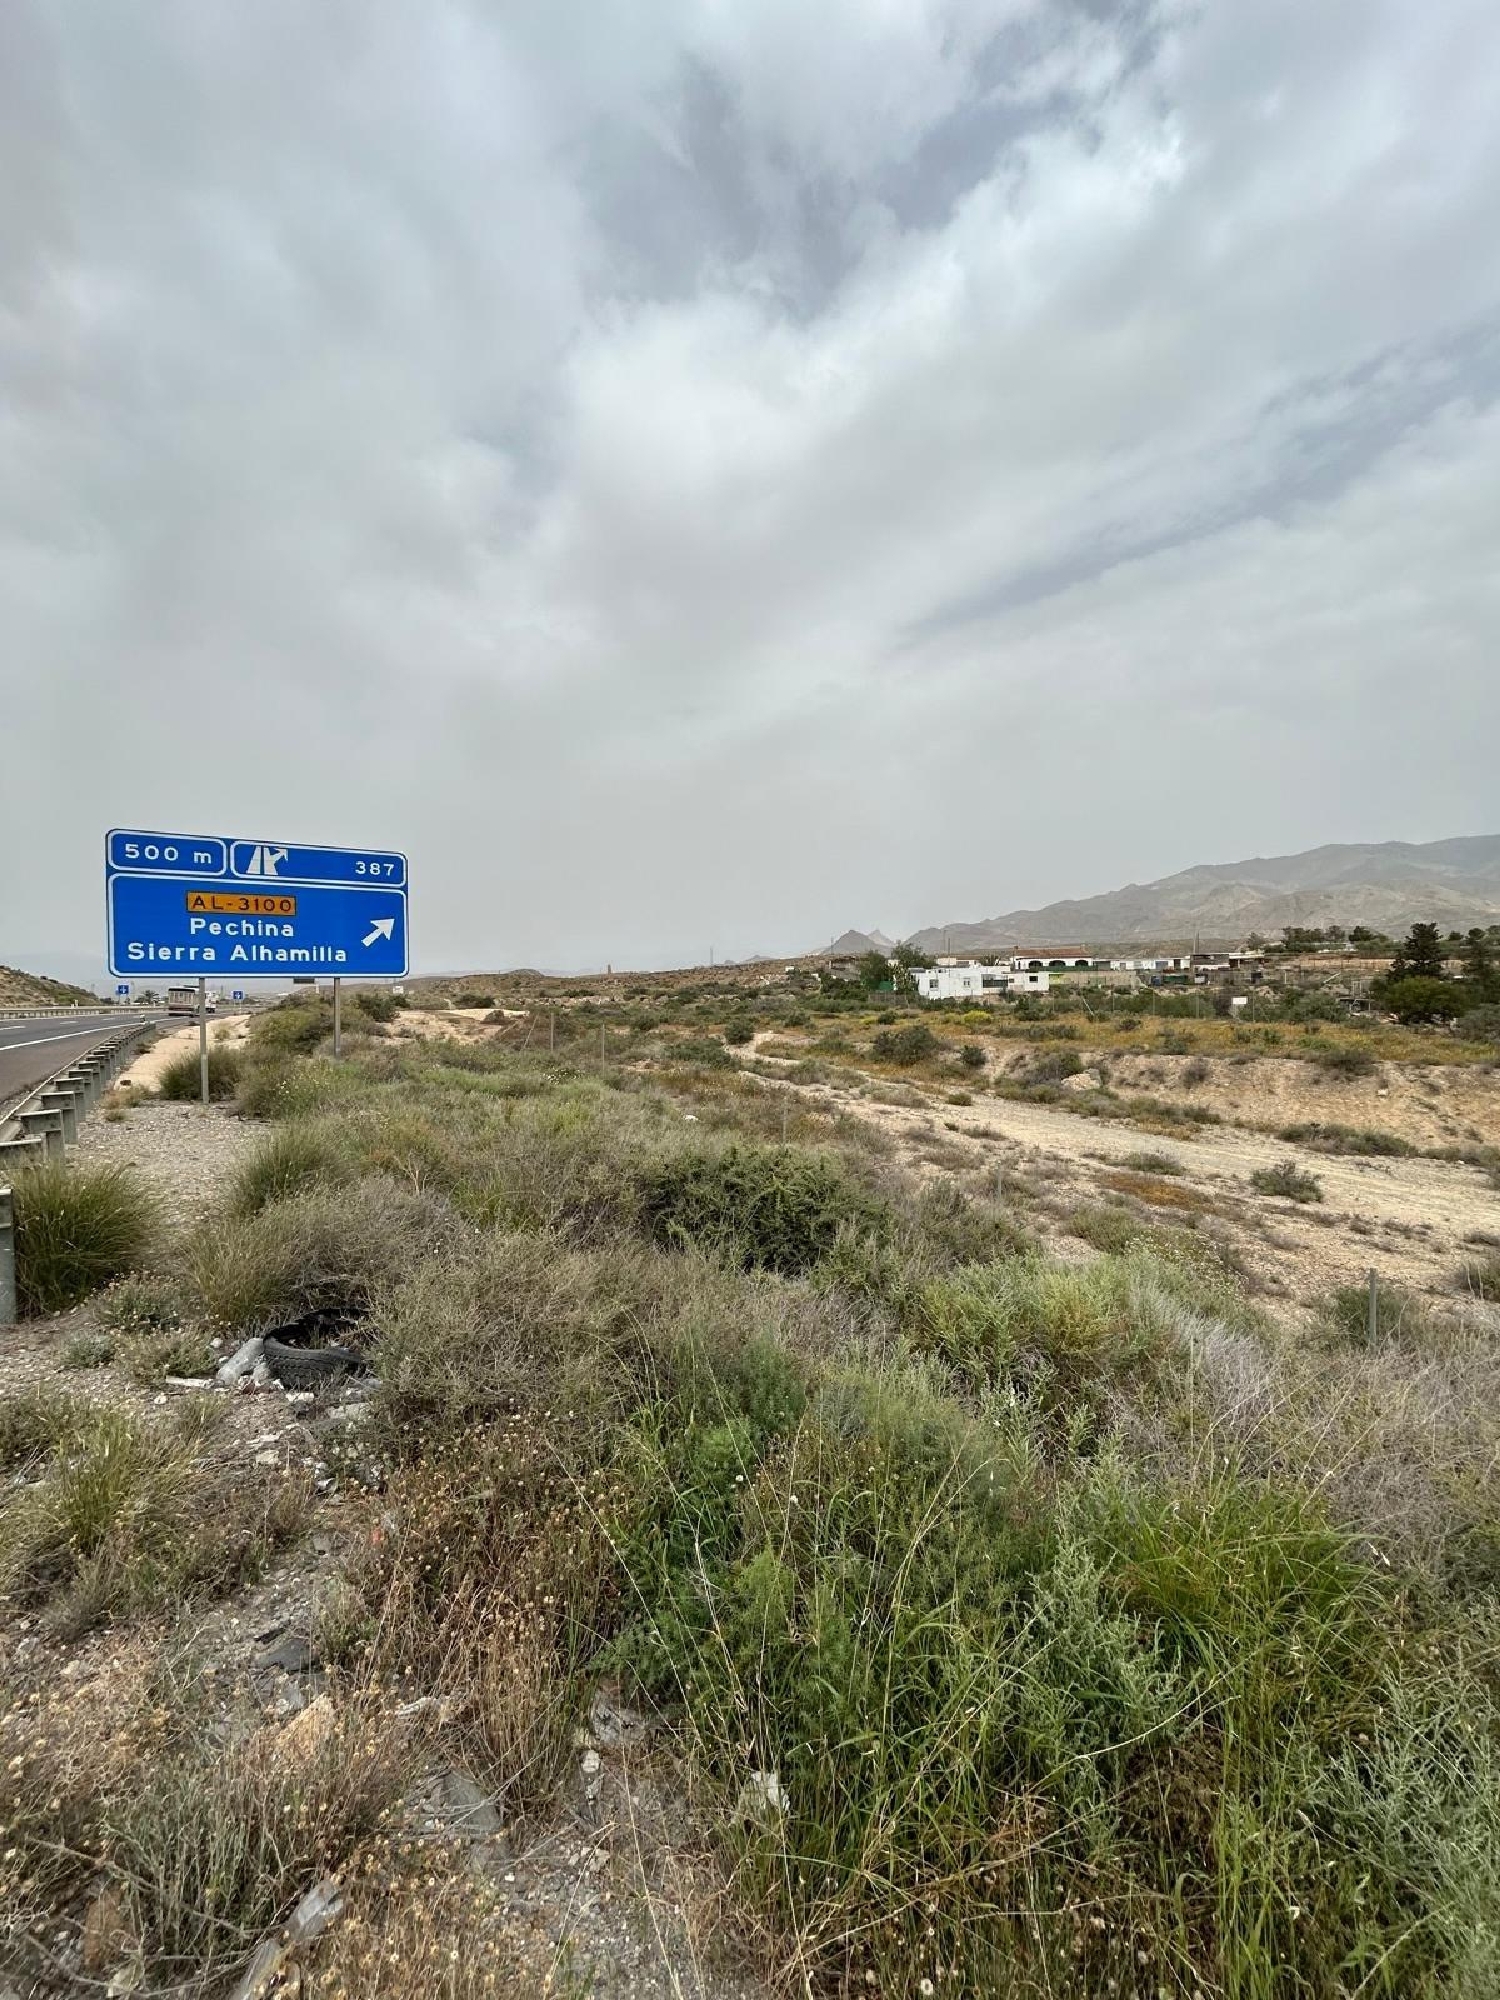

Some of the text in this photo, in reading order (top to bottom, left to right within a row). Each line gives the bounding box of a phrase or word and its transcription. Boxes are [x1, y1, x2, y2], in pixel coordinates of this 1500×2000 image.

[124, 843, 212, 864] 500 m
[355, 861, 395, 876] 387
[192, 894, 292, 912] AL-3100
[190, 918, 294, 936] Pechina
[128, 943, 347, 962] Sierra Alhamilla
